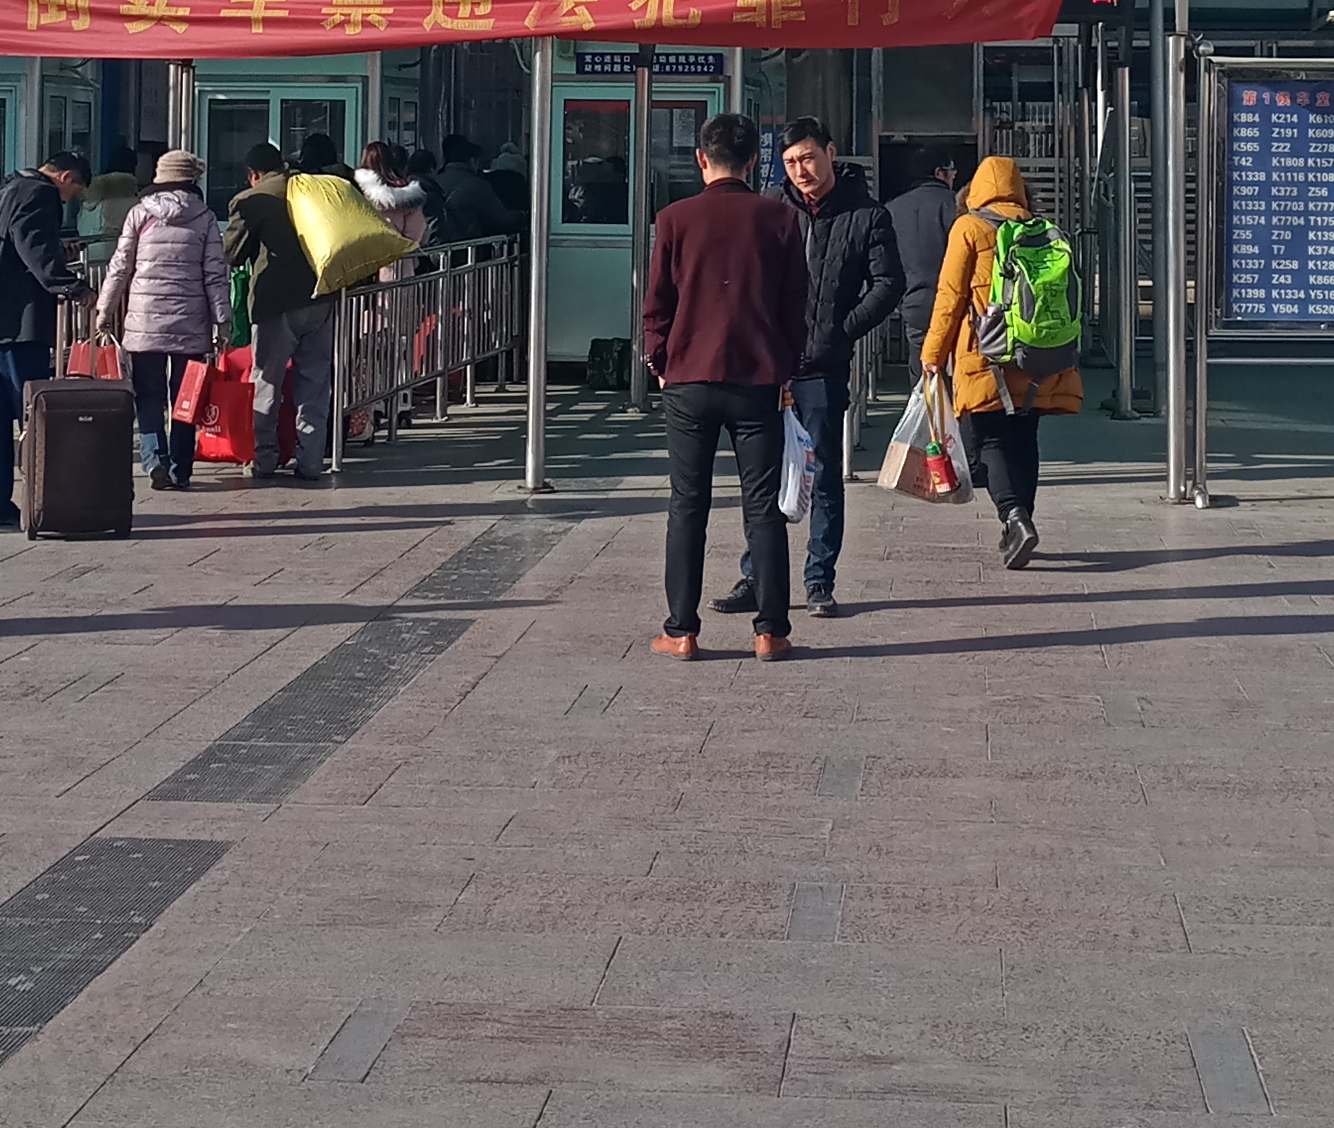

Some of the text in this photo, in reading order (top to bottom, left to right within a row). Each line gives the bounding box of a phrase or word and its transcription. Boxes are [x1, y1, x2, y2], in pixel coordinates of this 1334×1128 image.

[1234, 112, 1260, 123] K884
[1272, 112, 1299, 124] K214
[1234, 127, 1260, 138] K865
[1272, 127, 1298, 138] Z191
[1234, 141, 1260, 152] K565
[1271, 142, 1291, 153] Z22
[1233, 155, 1253, 167] T42
[1233, 185, 1259, 196] K907
[1272, 186, 1298, 196] K373
[1308, 186, 1329, 197] Z56
[1233, 199, 1266, 211] K1333
[1233, 214, 1266, 226] K1574
[1272, 215, 1305, 226] K7704
[1233, 229, 1253, 240] Z55
[1272, 229, 1292, 240] Z70
[1272, 244, 1286, 255] T7
[1233, 258, 1265, 269] K1337
[1233, 273, 1259, 284] K257
[1272, 273, 1292, 285] Z43
[1272, 288, 1306, 299] K1334
[1233, 302, 1266, 314] K7775
[1272, 303, 1299, 315] Y504
